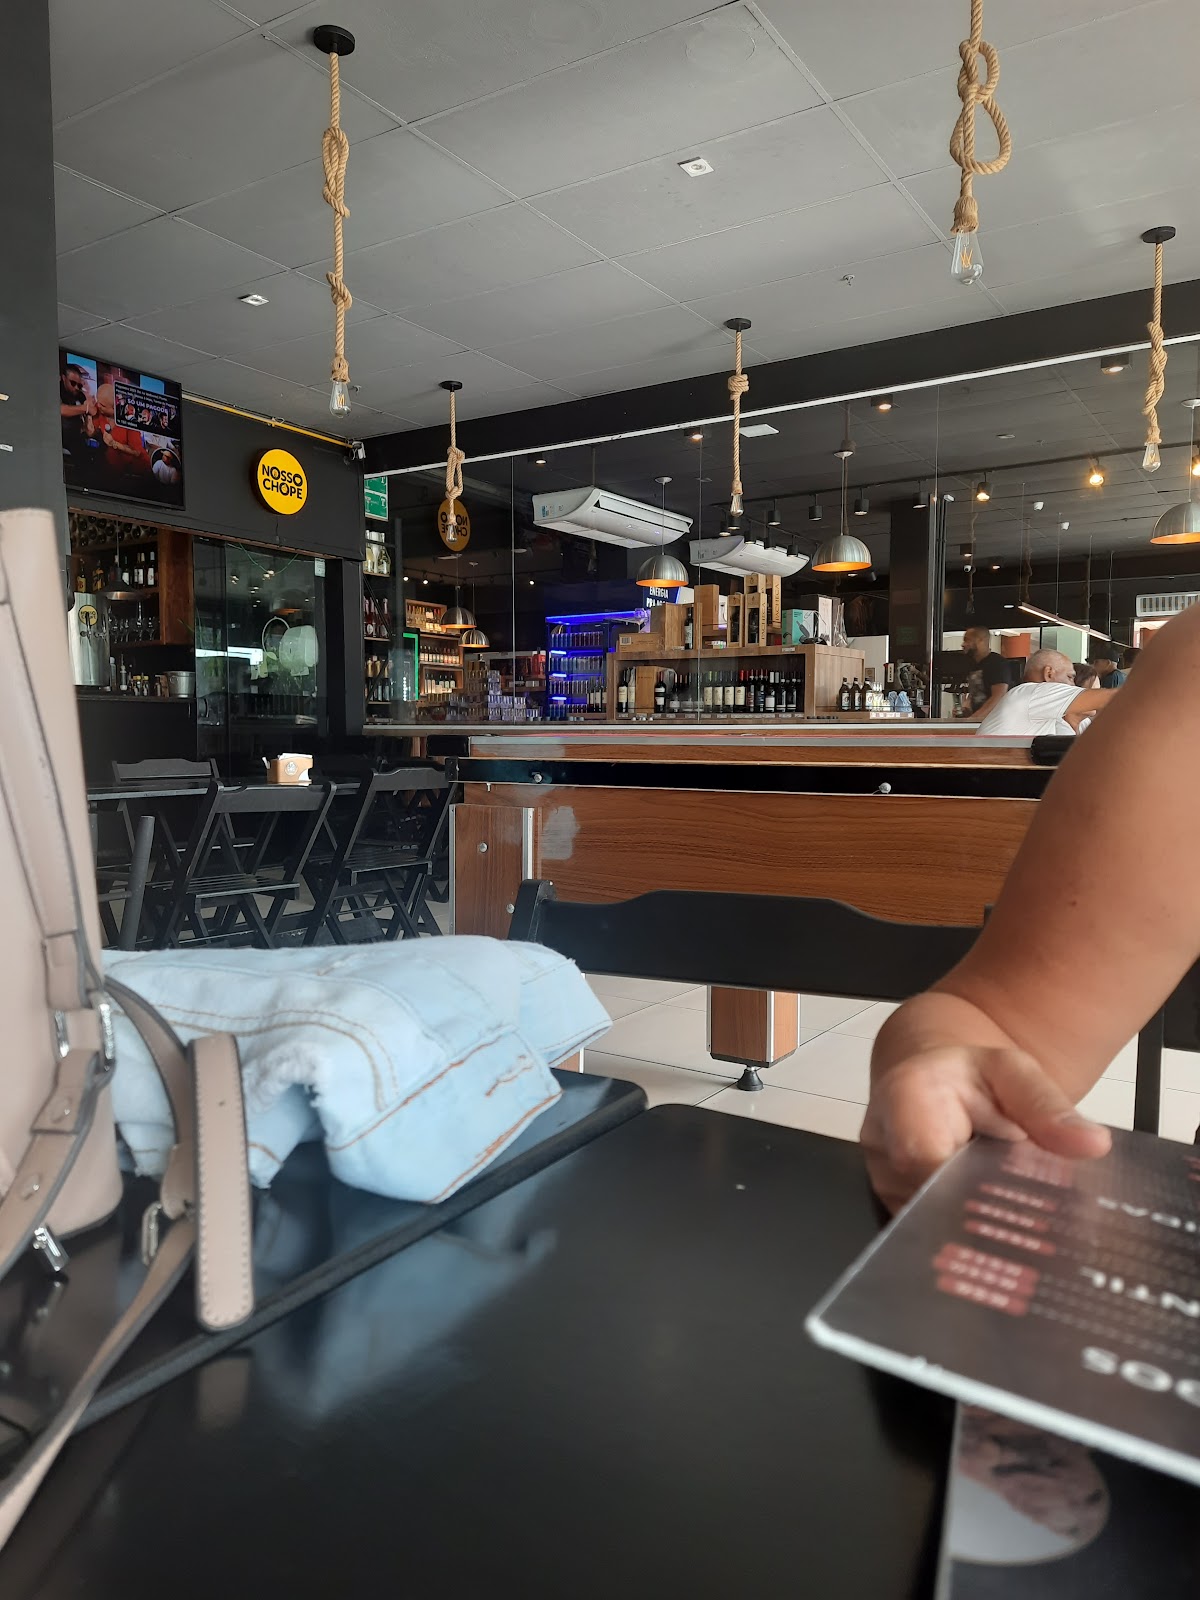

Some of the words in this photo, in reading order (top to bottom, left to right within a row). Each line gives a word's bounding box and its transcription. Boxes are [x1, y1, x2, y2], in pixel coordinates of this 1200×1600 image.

[136, 400, 146, 408] UM
[261, 463, 303, 487] NOSSO
[262, 478, 303, 500] CHOPE
[649, 586, 669, 599] ENERGIA
